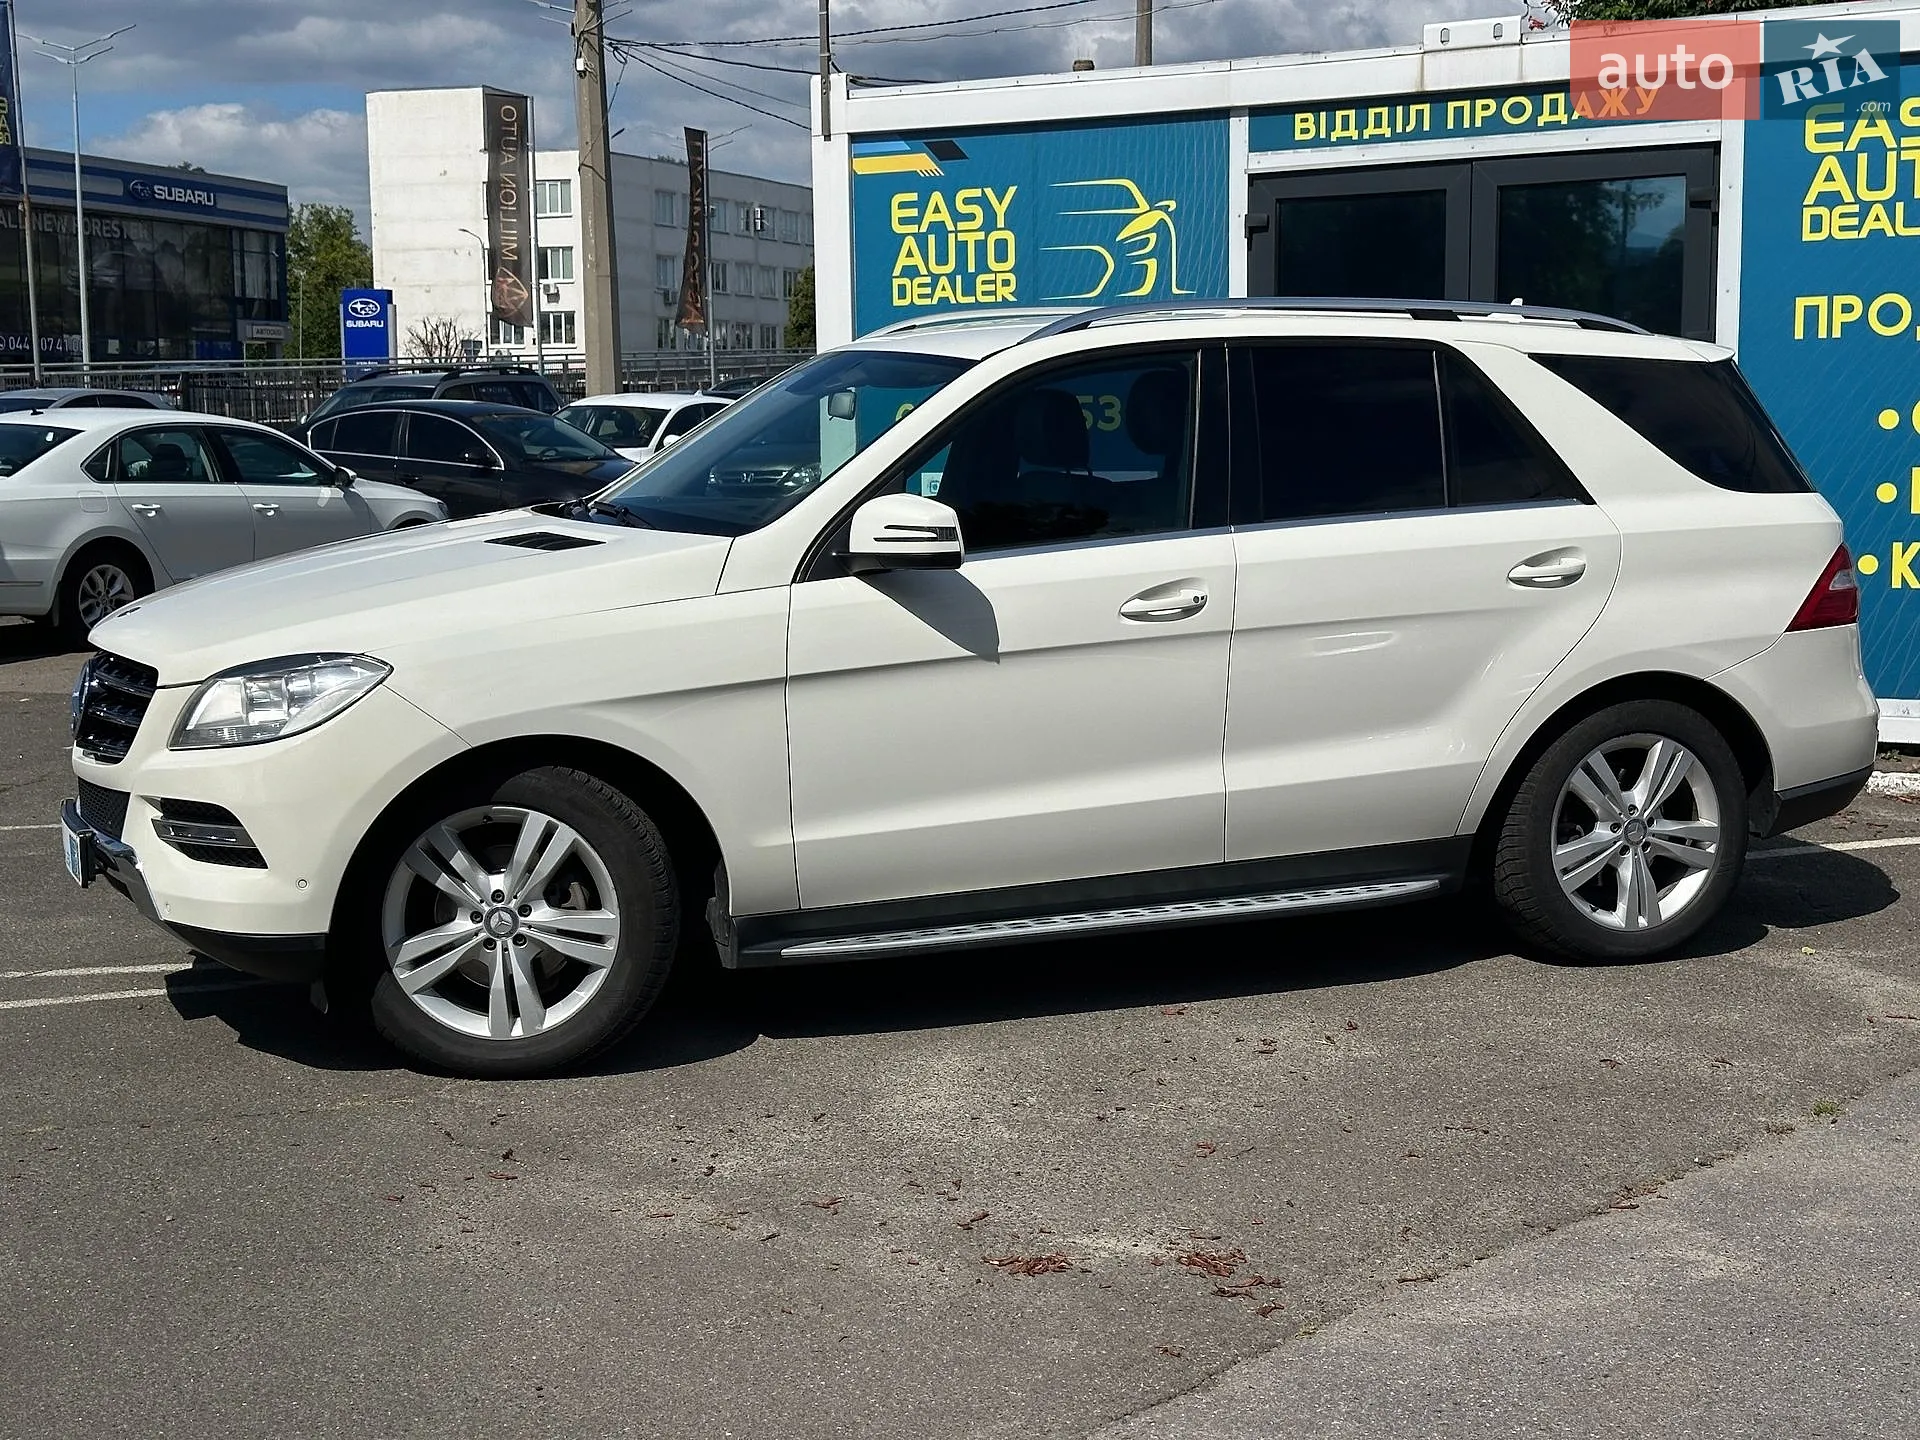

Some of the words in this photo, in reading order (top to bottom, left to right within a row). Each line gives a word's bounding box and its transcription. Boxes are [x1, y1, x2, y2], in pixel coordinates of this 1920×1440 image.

[1294, 103, 1431, 142] ВІДДІЛ
[1446, 87, 1659, 130] ПРОДАЖУ
[153, 185, 214, 207] SUBARU
[891, 185, 1018, 234] EASY
[892, 229, 1016, 277] AUTO
[892, 272, 1018, 307] DEALER
[346, 320, 384, 328] SUBARU
[1793, 292, 1920, 340] ПРО
